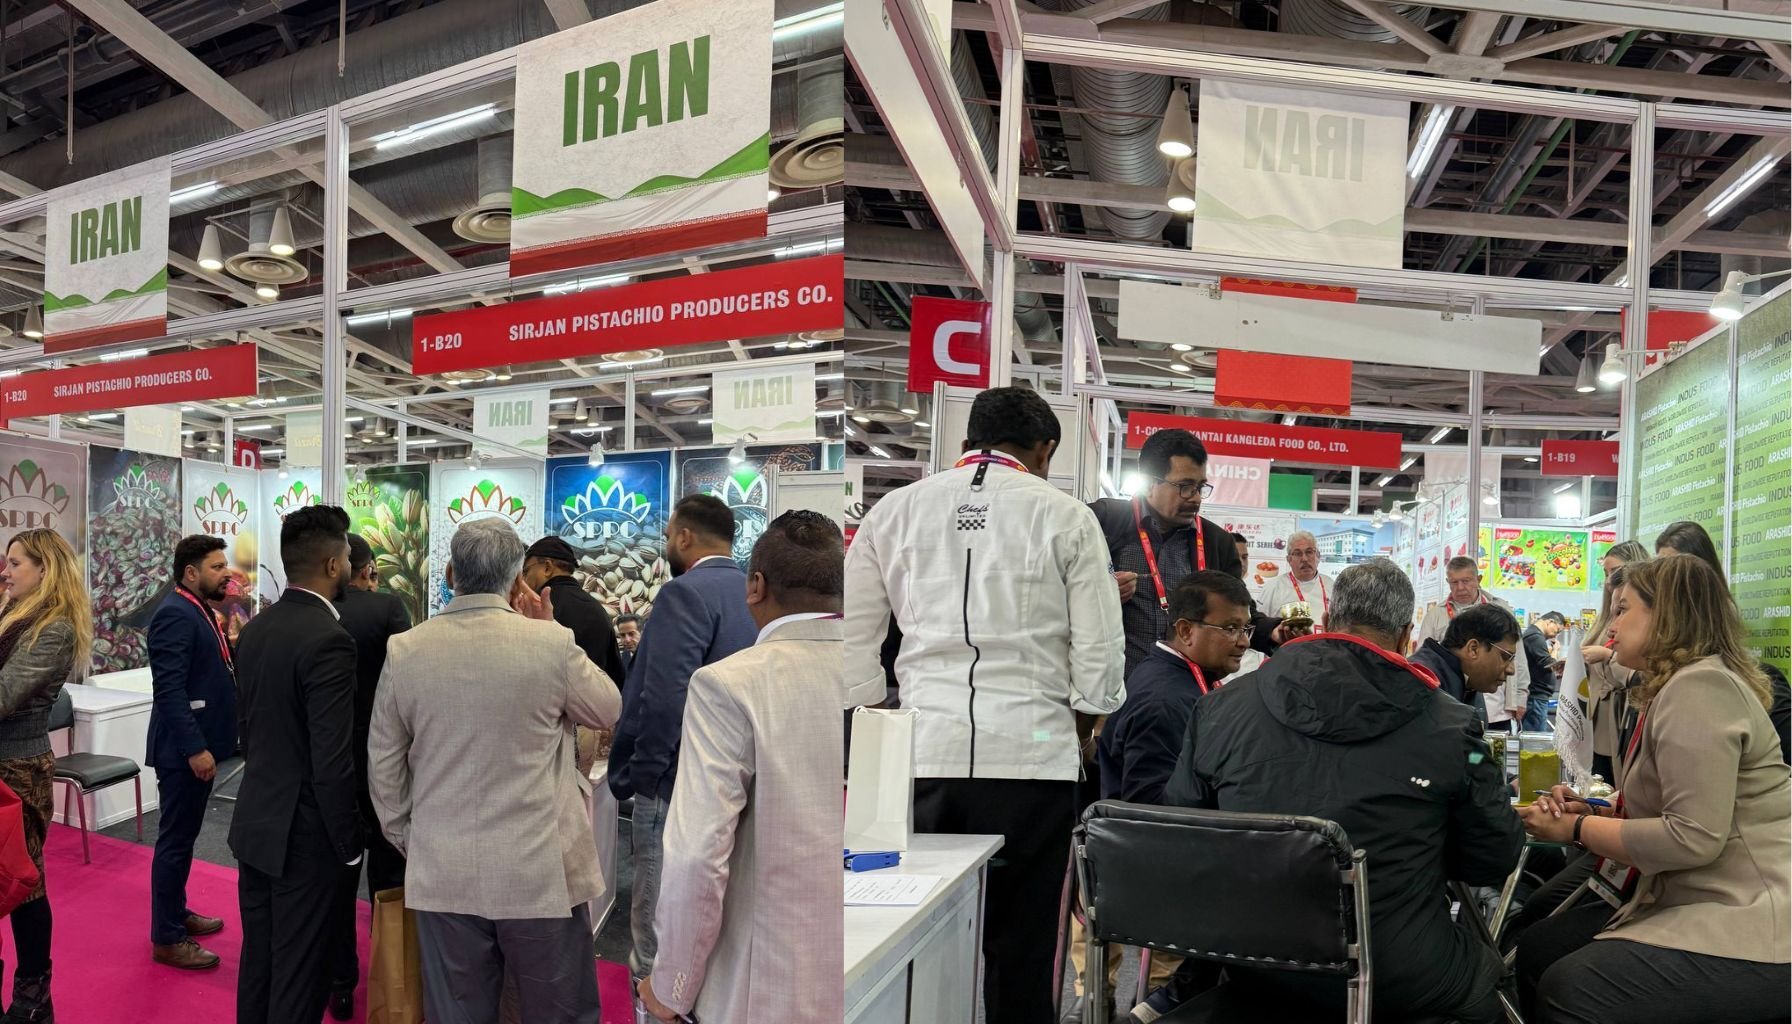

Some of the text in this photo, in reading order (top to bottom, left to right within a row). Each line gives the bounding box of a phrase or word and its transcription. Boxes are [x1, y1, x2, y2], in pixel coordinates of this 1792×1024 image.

[563, 35, 710, 147] IRAN
[70, 196, 142, 265] IRAN
[420, 284, 833, 353] 1-B20 SIRJAN PISTACHIO PRODUCERS CO.
[933, 320, 982, 376] C
[1678, 385, 1696, 404] INDUS
[1774, 328, 1791, 348] IND
[4, 367, 212, 403] 1-B20 SIRJAN PISTACHIO PRODUCERS CO.
[1226, 434, 1276, 447] KANGLEDA
[1279, 438, 1304, 449] FOOD
[1307, 440, 1326, 453] CO.,
[1329, 442, 1349, 453] LTD.
[1657, 427, 1672, 442] FOOD
[1548, 452, 1576, 463] 1-B19
[1674, 449, 1693, 466] INDUS
[1696, 441, 1715, 458] FOOD
[1744, 454, 1764, 472] FOOD
[1694, 507, 1712, 523] FOOD
[202, 520, 240, 536] SPPC
[572, 520, 638, 540] SPPC
[1742, 530, 1761, 546] FOOD
[1762, 604, 1790, 618] ARASHID
[1764, 646, 1790, 659] INDUS
